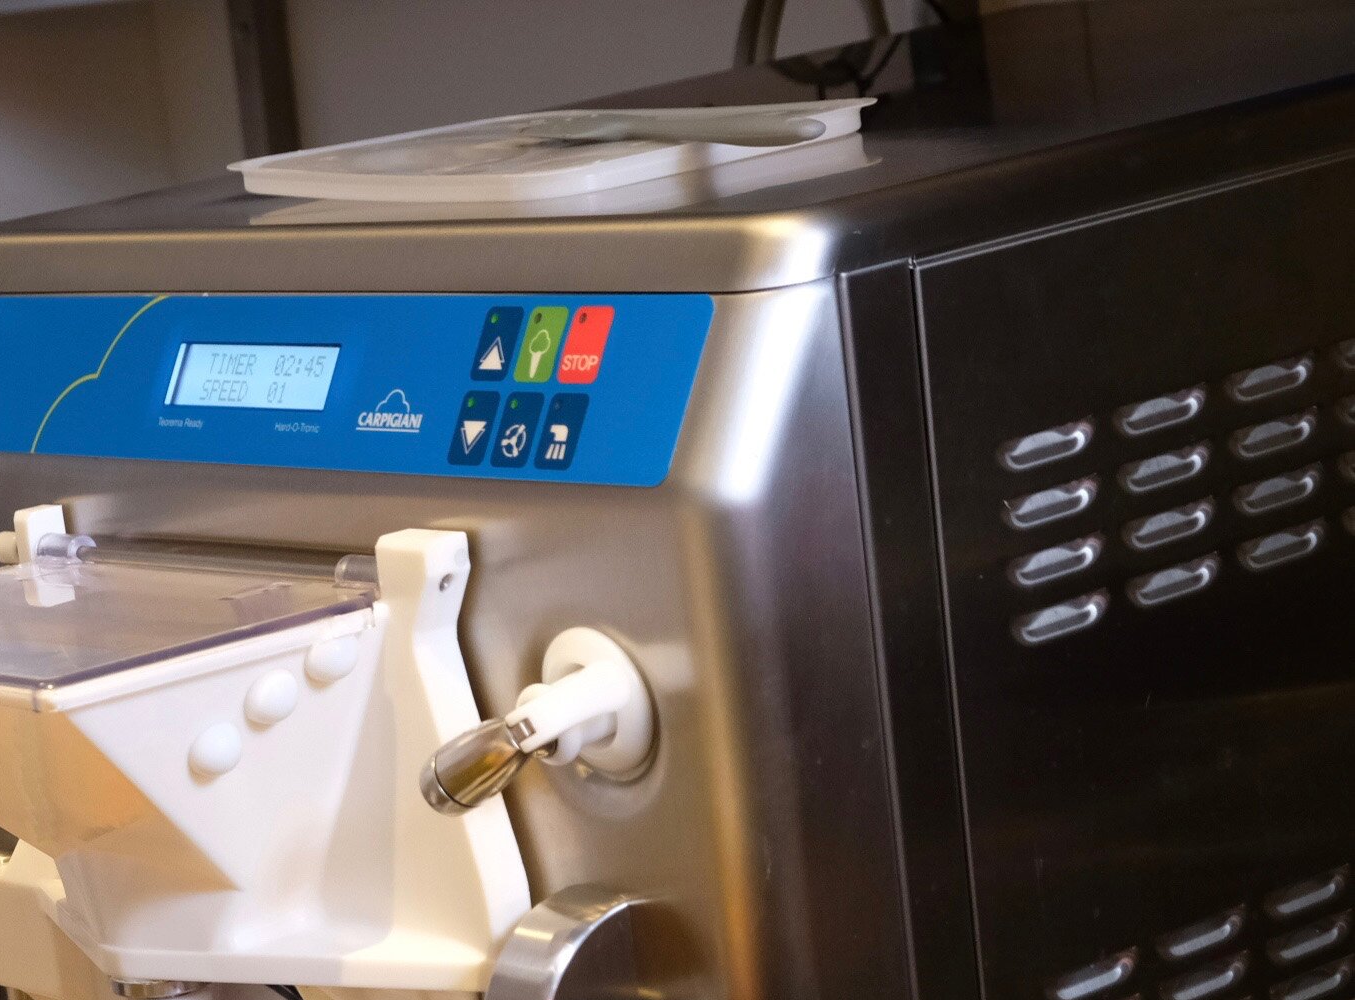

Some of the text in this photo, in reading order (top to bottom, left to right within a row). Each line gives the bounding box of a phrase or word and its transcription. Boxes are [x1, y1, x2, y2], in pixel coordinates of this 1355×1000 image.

[208, 353, 327, 378] TIMER 02:45
[561, 354, 599, 371] STOP
[199, 379, 287, 403] SPEED 01
[184, 417, 204, 430] Ready
[357, 411, 423, 428] CARPIGIANI
